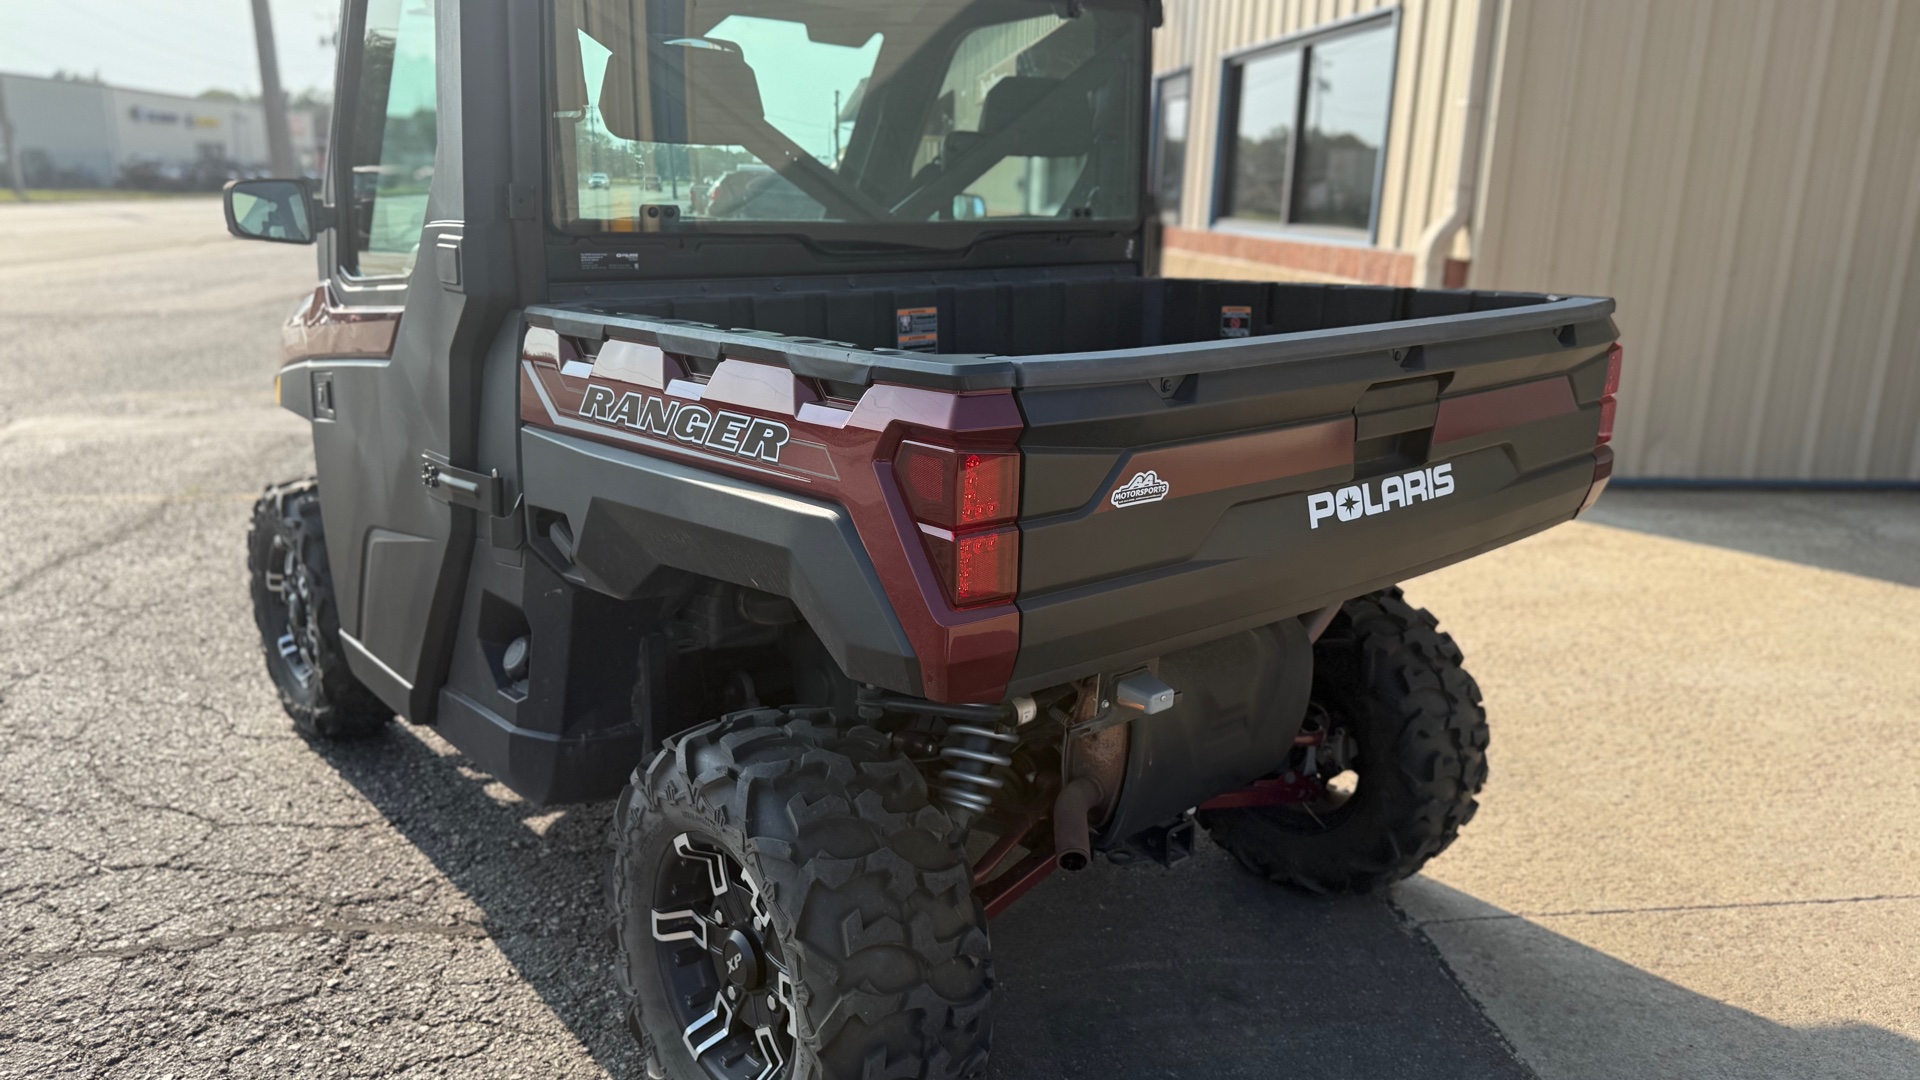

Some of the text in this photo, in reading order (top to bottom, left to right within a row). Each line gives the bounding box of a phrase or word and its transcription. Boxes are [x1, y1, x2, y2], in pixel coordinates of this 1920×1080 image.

[579, 384, 790, 464] RANGER
[1114, 485, 1167, 501] MOTORSPORTS
[1307, 463, 1455, 529] POLARIS
[726, 952, 742, 974] XP
